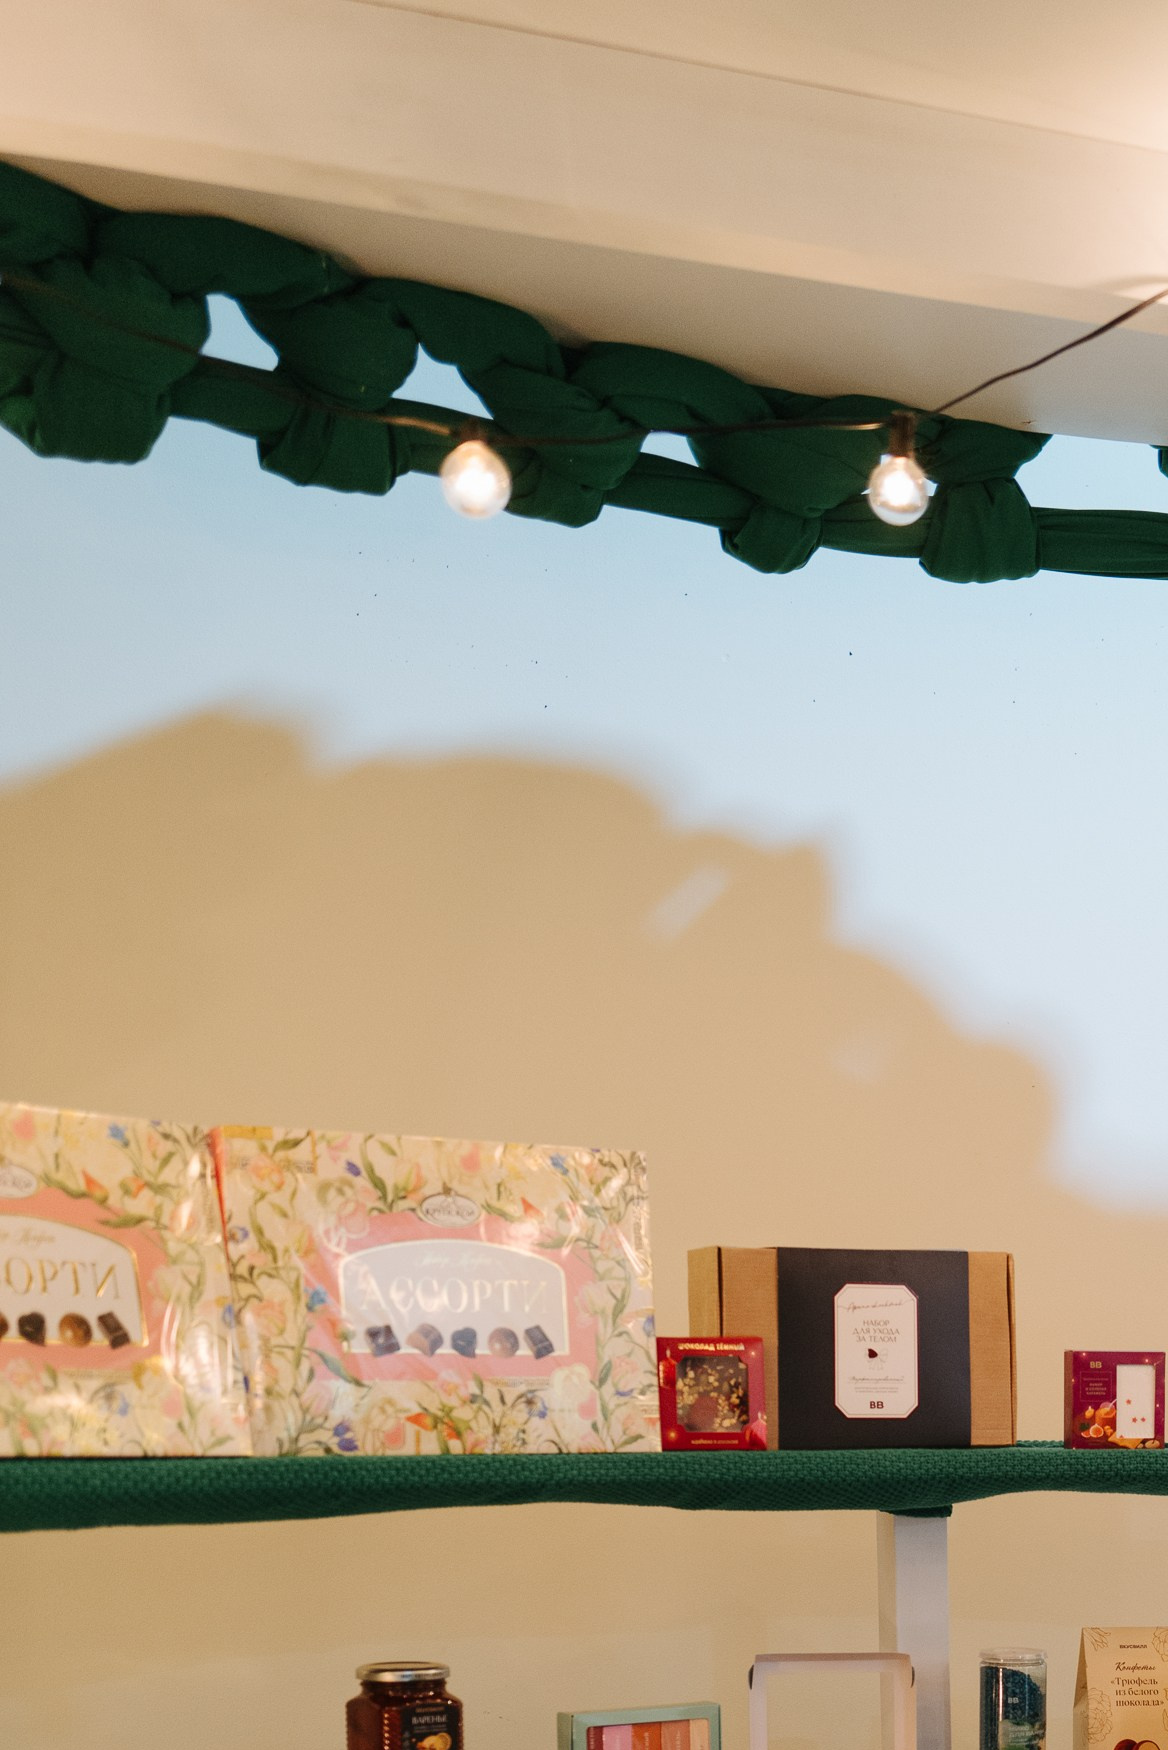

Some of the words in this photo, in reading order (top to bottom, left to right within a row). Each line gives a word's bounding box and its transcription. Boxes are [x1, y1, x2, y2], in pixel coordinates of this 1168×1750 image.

[359, 1277, 548, 1315] АССОРТИ
[852, 1328, 871, 1336] ДЛЯ
[872, 1328, 900, 1336] УХОДА
[677, 1342, 715, 1351] ШОКОЛАД
[1114, 1661, 1156, 1672] Конфеты
[1110, 1676, 1158, 1687] «Трюфель
[1128, 1687, 1159, 1696] белого
[1116, 1699, 1164, 1707] шоколада»
[412, 1714, 447, 1724] ВАРЕНЬЕ
